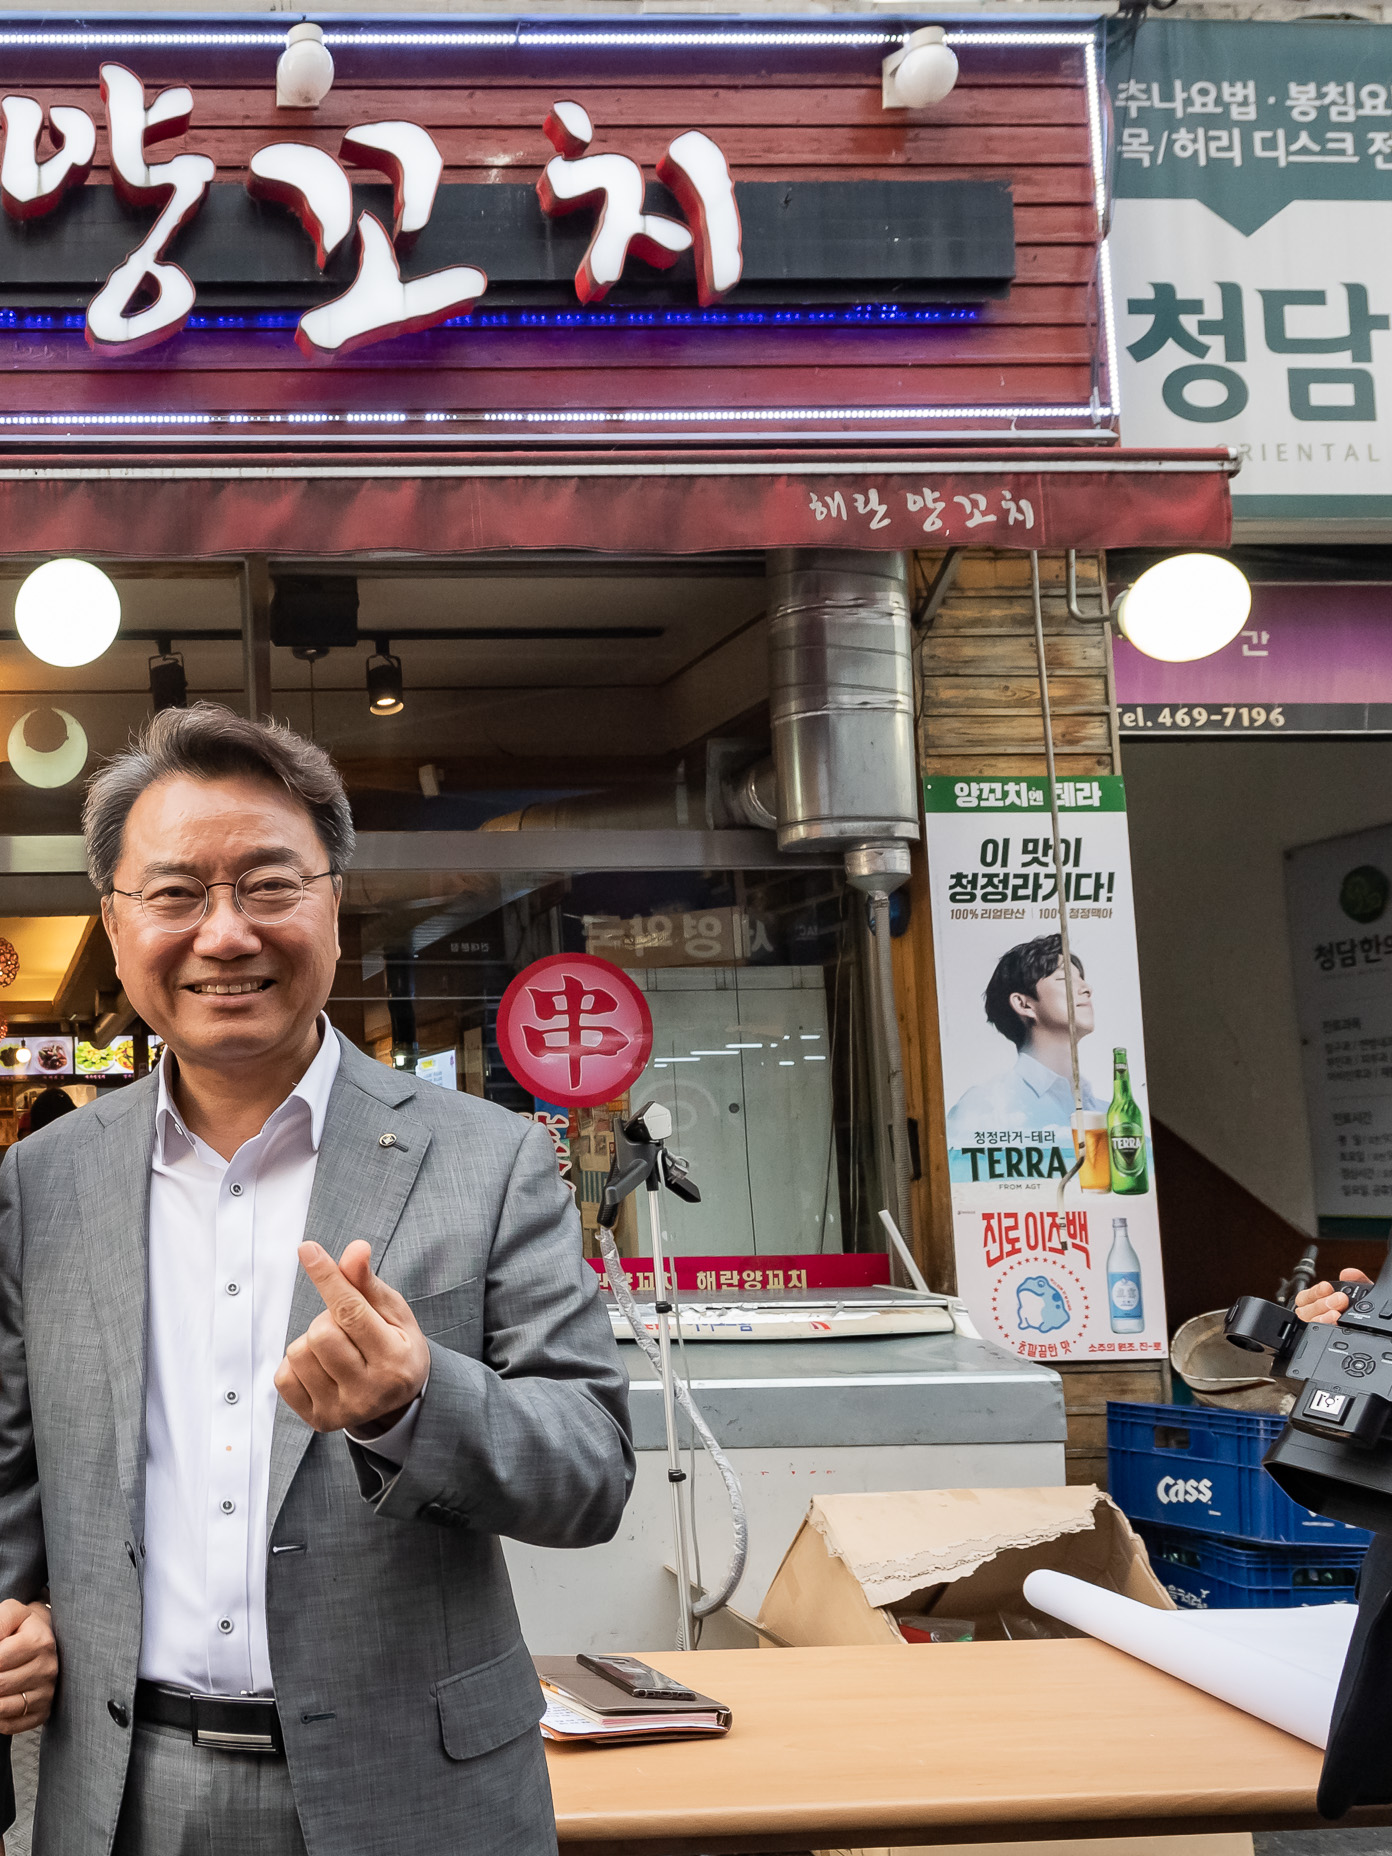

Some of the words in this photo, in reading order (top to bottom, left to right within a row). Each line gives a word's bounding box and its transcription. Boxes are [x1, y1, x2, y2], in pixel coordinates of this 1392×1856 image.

[1115, 79, 1258, 121] 추나요법
[1285, 81, 1392, 122] 봉침요
[1118, 127, 1242, 168] 목/허리
[1254, 128, 1360, 167] 디스크
[1126, 281, 1391, 424] 청담
[1157, 706, 1286, 728] 469-7196
[1054, 781, 1102, 807] 테라
[980, 838, 1010, 868] 이
[1021, 837, 1082, 868] 맛이
[519, 973, 631, 1091] 串
[1111, 1137, 1142, 1150] TERRA
[961, 1146, 1068, 1182] TERRA
[982, 1211, 1022, 1268] 진로
[696, 1269, 808, 1291] 해란양꼬치
[1157, 1475, 1213, 1505] Cass
